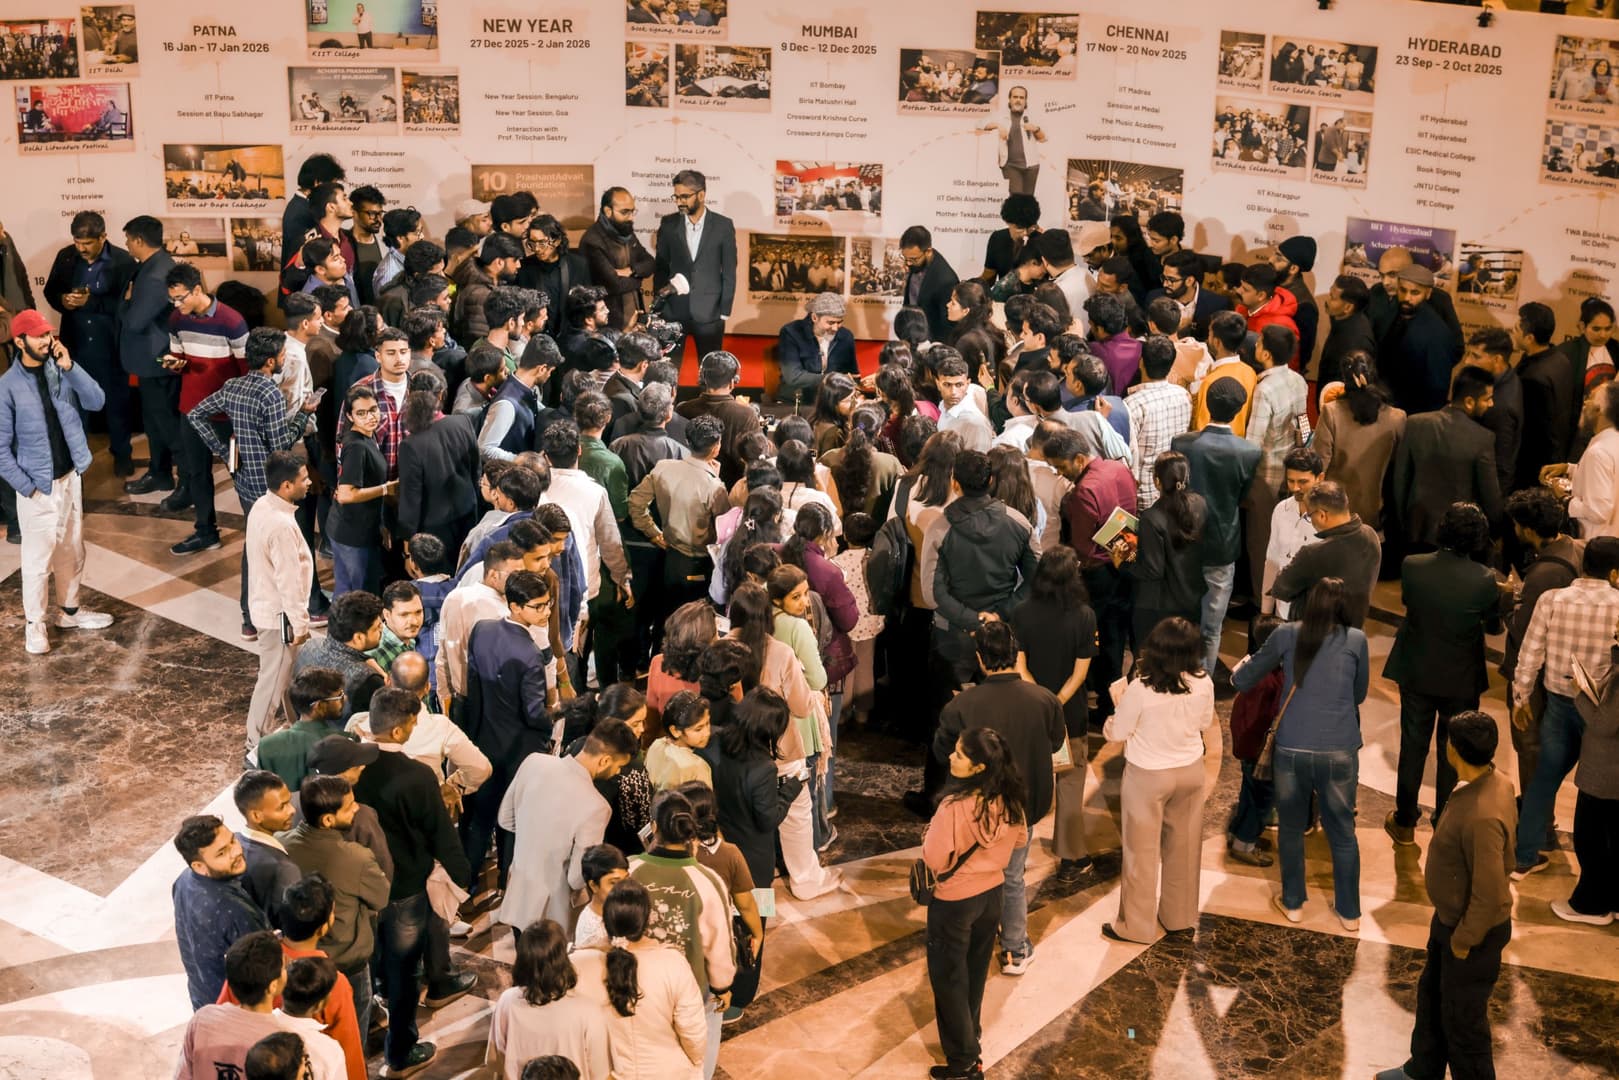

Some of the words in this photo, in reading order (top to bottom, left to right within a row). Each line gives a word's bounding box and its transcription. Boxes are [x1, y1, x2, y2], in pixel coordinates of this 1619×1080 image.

[483, 19, 523, 32] NEW
[528, 19, 572, 32] YEAR
[193, 26, 236, 36] PATNA
[802, 25, 857, 38] MUMBAI
[1106, 25, 1168, 42] CHENNAI
[163, 42, 173, 51] 16
[177, 42, 196, 52] Jan
[206, 43, 216, 52] 17
[220, 43, 240, 52] Jan
[243, 43, 269, 52] 2026
[470, 40, 481, 48] 27
[484, 40, 502, 48] Dec
[505, 40, 529, 48] 2025
[566, 40, 590, 48] 2026
[790, 43, 808, 52] Dec
[818, 44, 827, 52] 12
[830, 45, 849, 53] Dec
[852, 45, 877, 54] 2025
[1409, 38, 1501, 58] HYDERABAD
[1087, 43, 1096, 52] 17
[1098, 44, 1117, 52] Nov
[1142, 47, 1160, 56] Nov
[1162, 49, 1187, 60] 2025
[1396, 56, 1409, 65] 23
[1412, 57, 1432, 68] Sep
[1443, 61, 1448, 69] 2
[1453, 62, 1470, 72] Oct
[1474, 64, 1502, 75] 2025
[1431, 116, 1467, 125] Hyderabad
[1135, 122, 1164, 131] Academy
[1086, 134, 1135, 144] Higginbothams
[1143, 139, 1176, 148] Crossword
[1430, 133, 1466, 143] Hyderabad
[1423, 150, 1449, 158] Medical
[1450, 152, 1475, 161] College
[1435, 168, 1461, 177] Signing
[480, 172, 506, 191] 10
[1435, 185, 1460, 193] College
[1267, 191, 1301, 200] Kharagpur
[1429, 201, 1454, 210] College
[1274, 208, 1309, 217] Auditorium
[1590, 258, 1616, 268] Signing
[35, 277, 45, 286] 18
